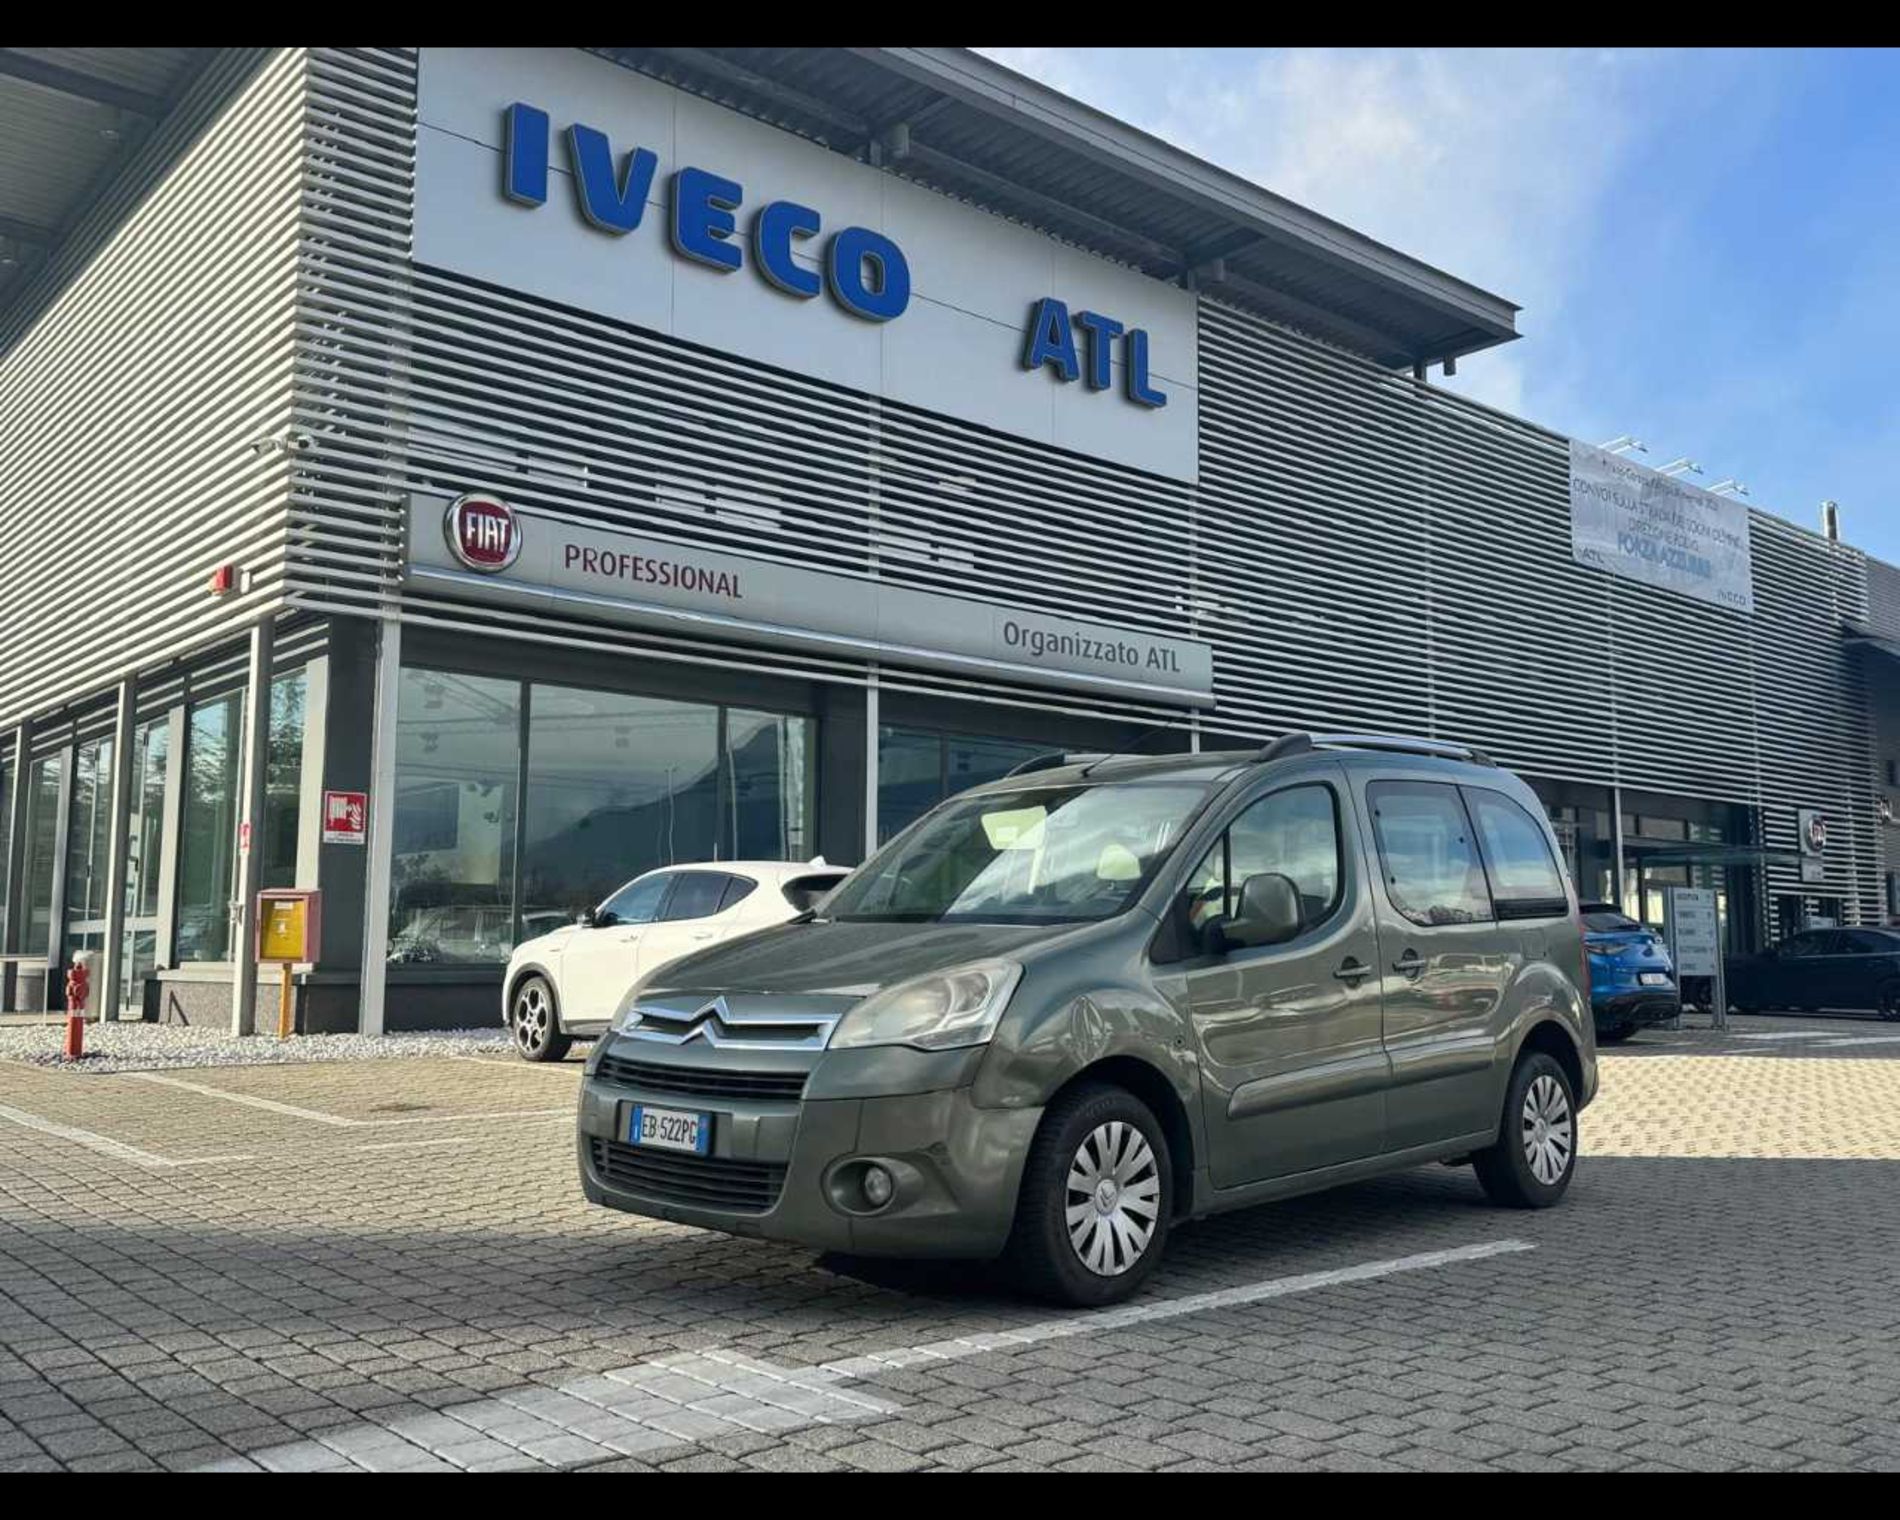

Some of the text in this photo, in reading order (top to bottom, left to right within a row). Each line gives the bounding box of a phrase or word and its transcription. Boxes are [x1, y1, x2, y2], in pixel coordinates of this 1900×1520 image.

[506, 101, 1167, 408] IVECO ATL
[465, 511, 510, 553] FIAT
[564, 543, 743, 599] PROFESSIONAL
[1003, 621, 1181, 673] Organizzato ATL
[641, 1114, 657, 1139] EB
